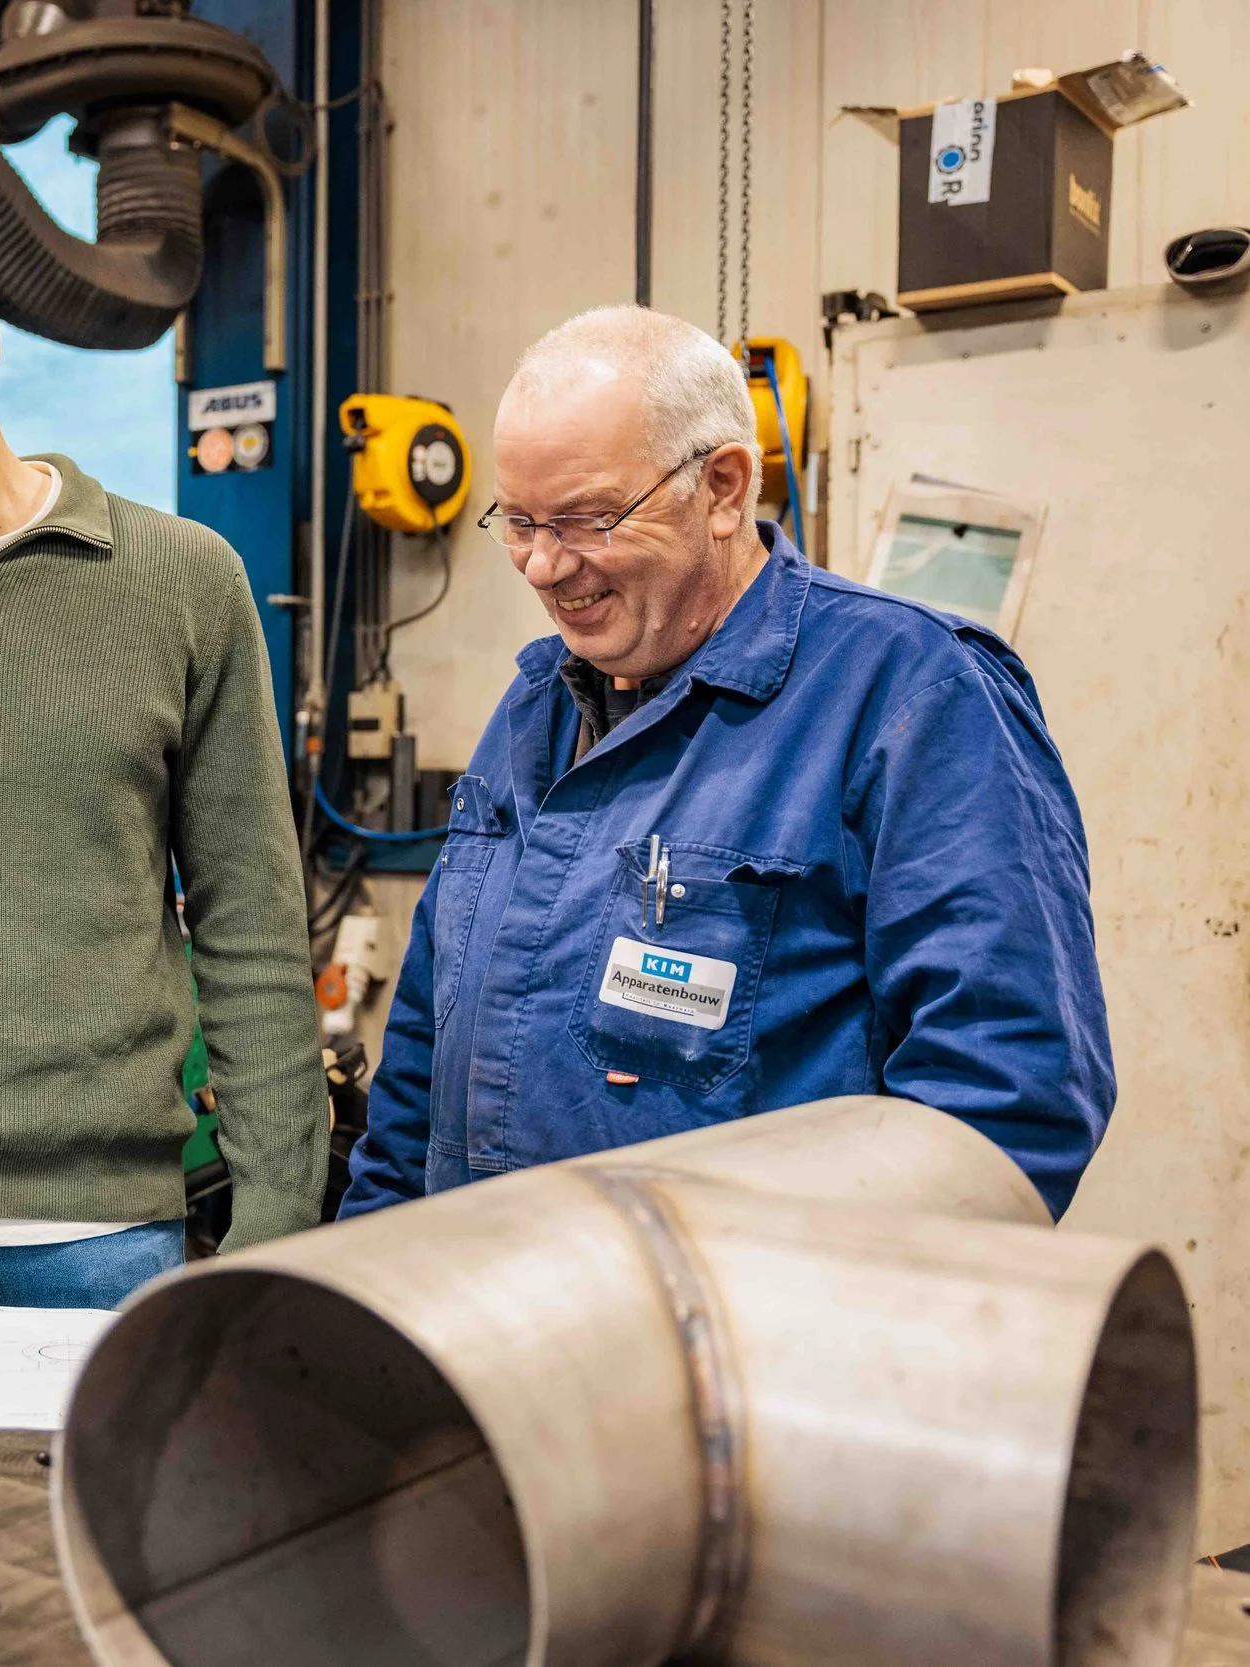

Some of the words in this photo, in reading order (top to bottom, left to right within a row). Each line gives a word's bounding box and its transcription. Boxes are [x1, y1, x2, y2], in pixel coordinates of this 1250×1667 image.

[203, 392, 262, 413] ABUS
[646, 957, 685, 977] KIM
[612, 970, 721, 1007] Apparatenbouw
